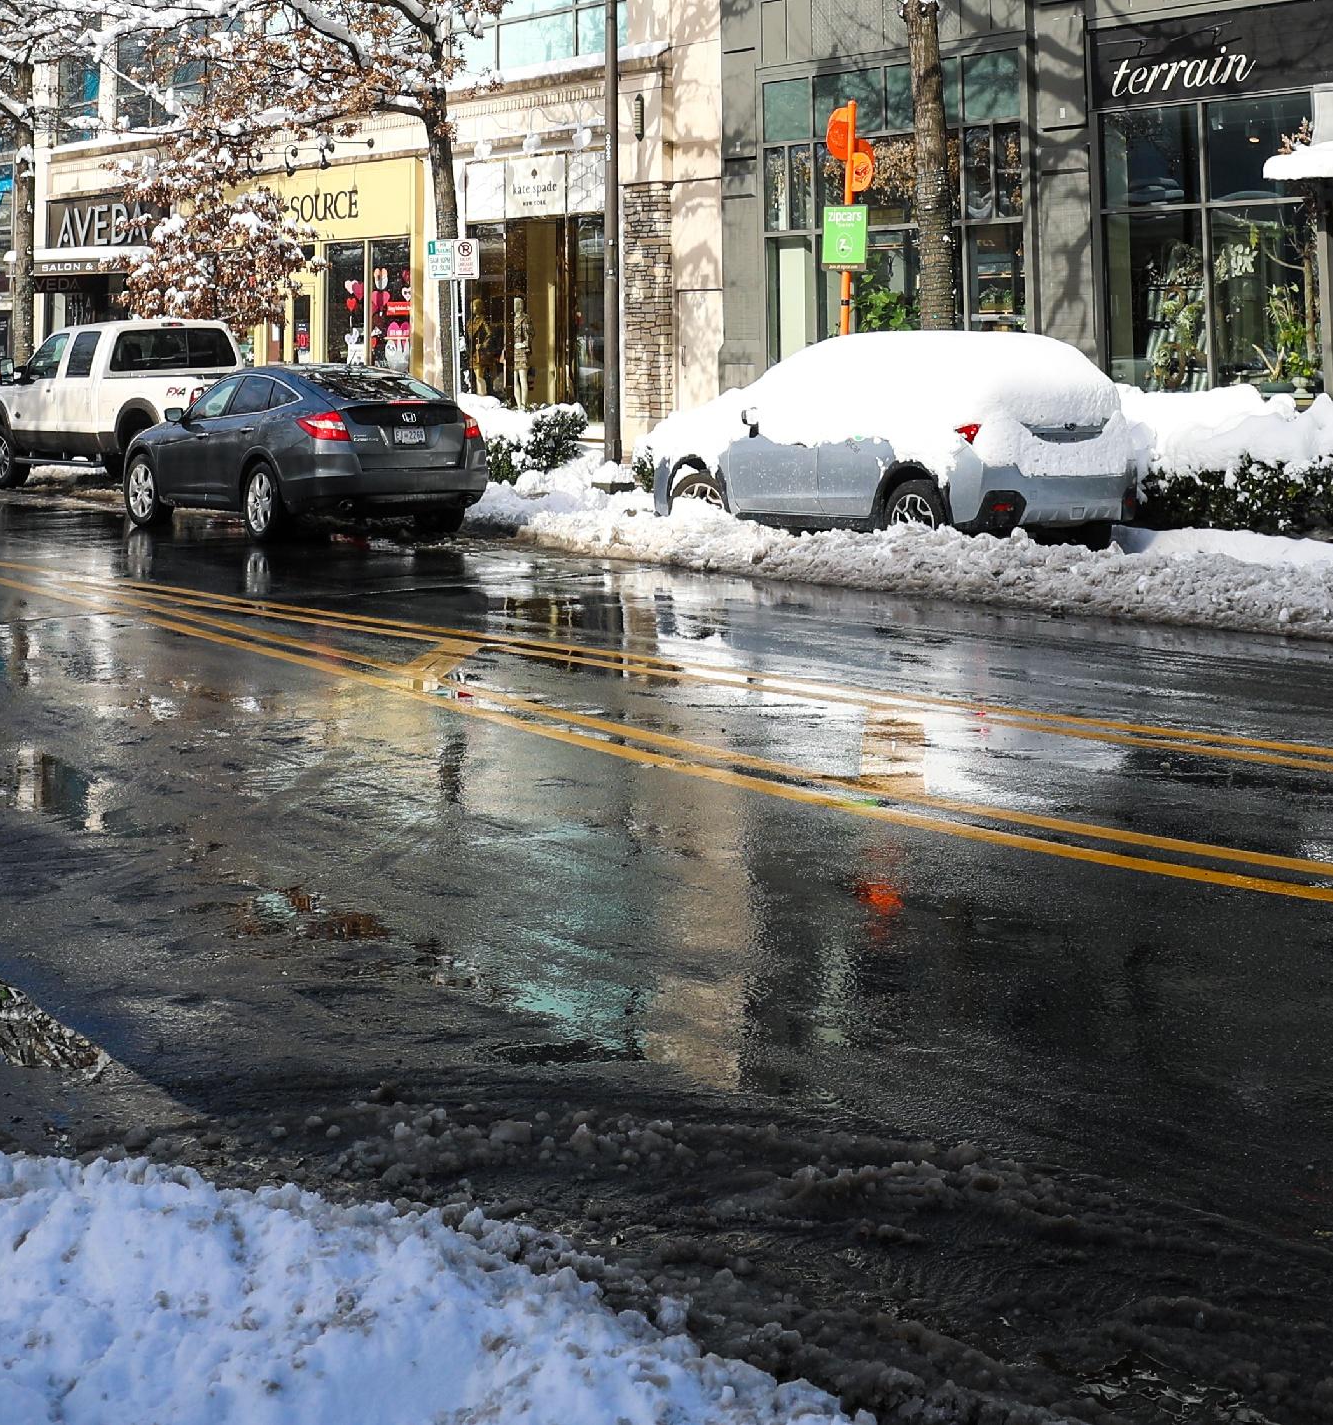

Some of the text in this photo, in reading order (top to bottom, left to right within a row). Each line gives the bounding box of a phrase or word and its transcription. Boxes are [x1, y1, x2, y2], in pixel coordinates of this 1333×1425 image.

[1111, 46, 1256, 98] terrain
[512, 180, 557, 197] kate spade
[290, 189, 359, 223] SOURCE
[57, 202, 148, 248] AVEDA
[828, 210, 862, 225] zipcars
[41, 262, 81, 272] SALON
[86, 262, 93, 271] &
[34, 277, 81, 292] VEDA
[166, 387, 187, 396] FX4
